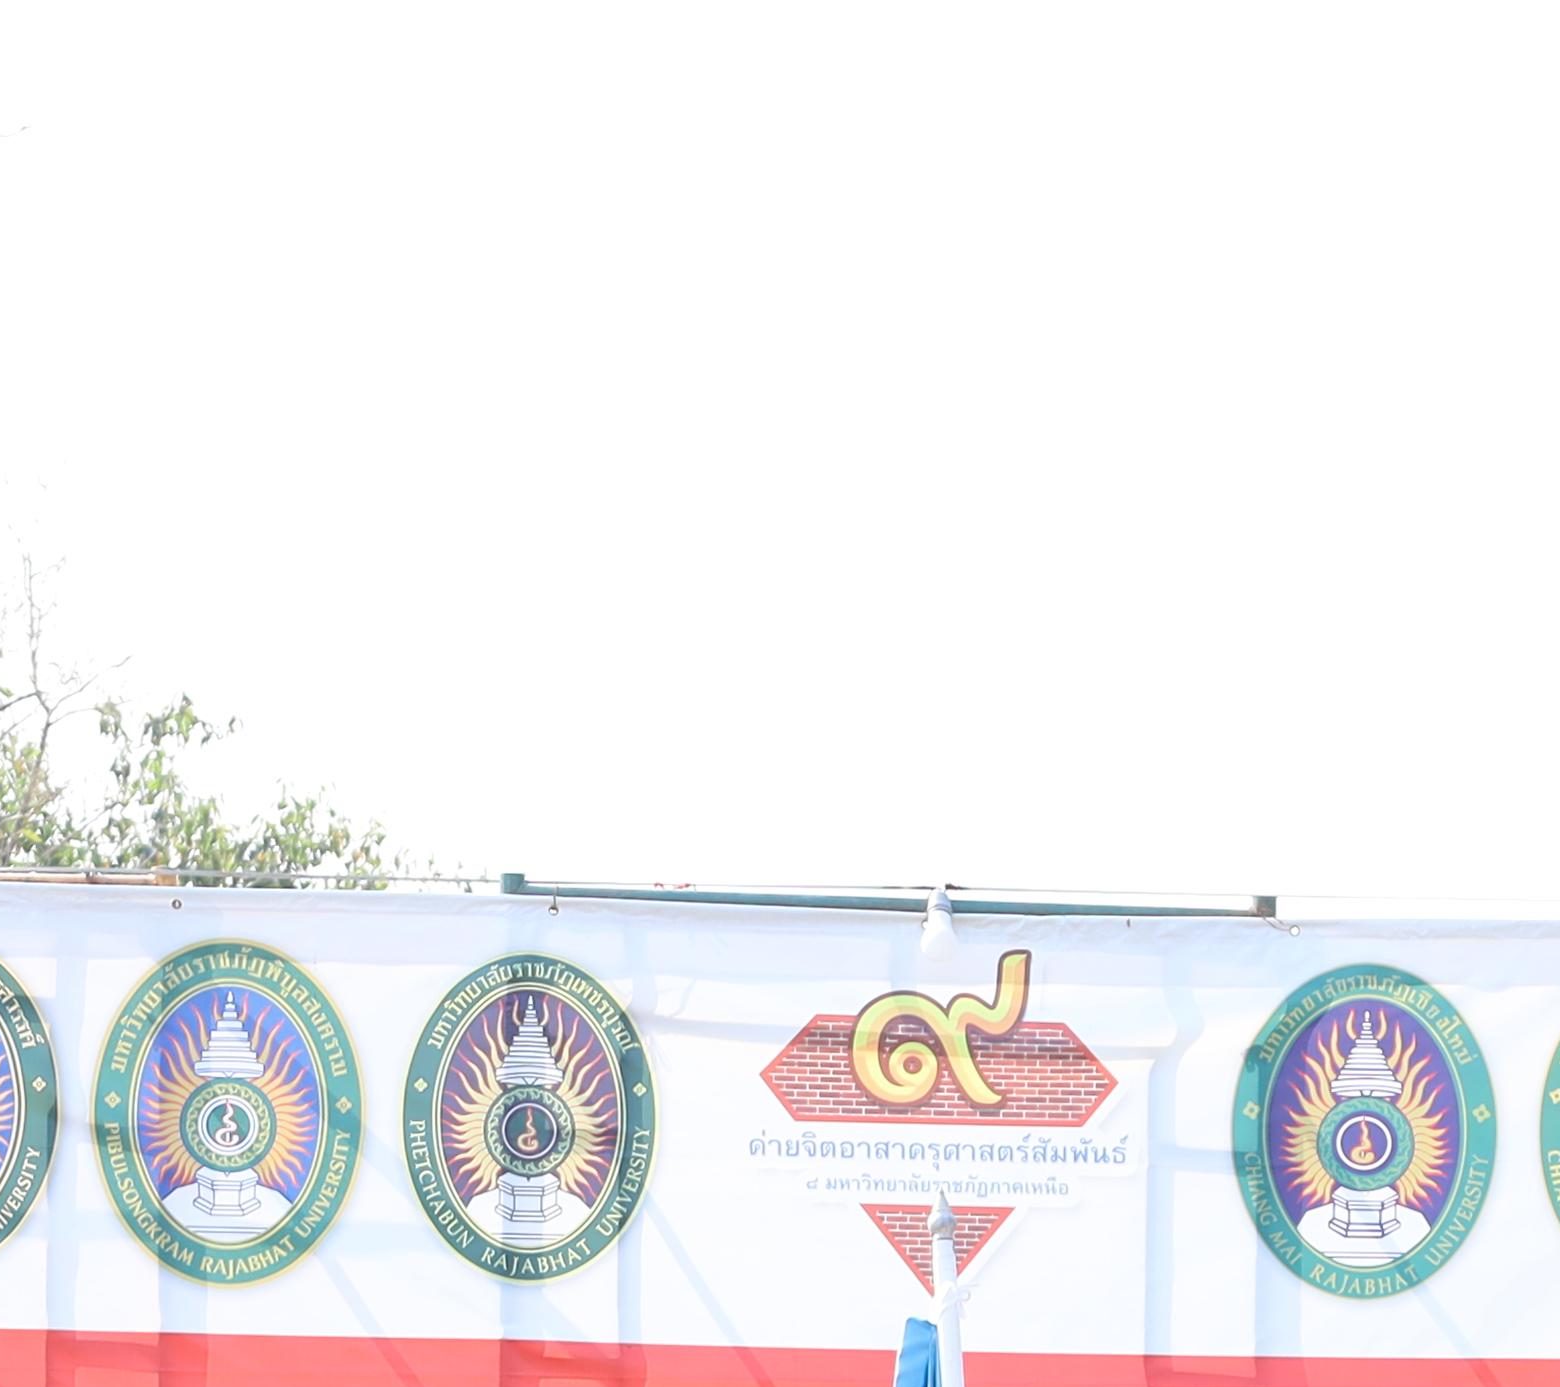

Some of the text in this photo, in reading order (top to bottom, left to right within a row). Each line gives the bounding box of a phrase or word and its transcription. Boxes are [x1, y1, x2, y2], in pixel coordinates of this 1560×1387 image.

[104, 1121, 352, 1280] PIBULSONGKRAM RAJABHAT UNIVERSITY
[409, 1119, 651, 1276] PHETCHABUN RAJABHAT UNIVERSITY
[749, 1129, 1130, 1170] ค่ายจิตอาสาครุศาสตร์สัมพันธ์
[1244, 1152, 1489, 1295] CHIANG MAI RAJABHAT UNIVERSITY
